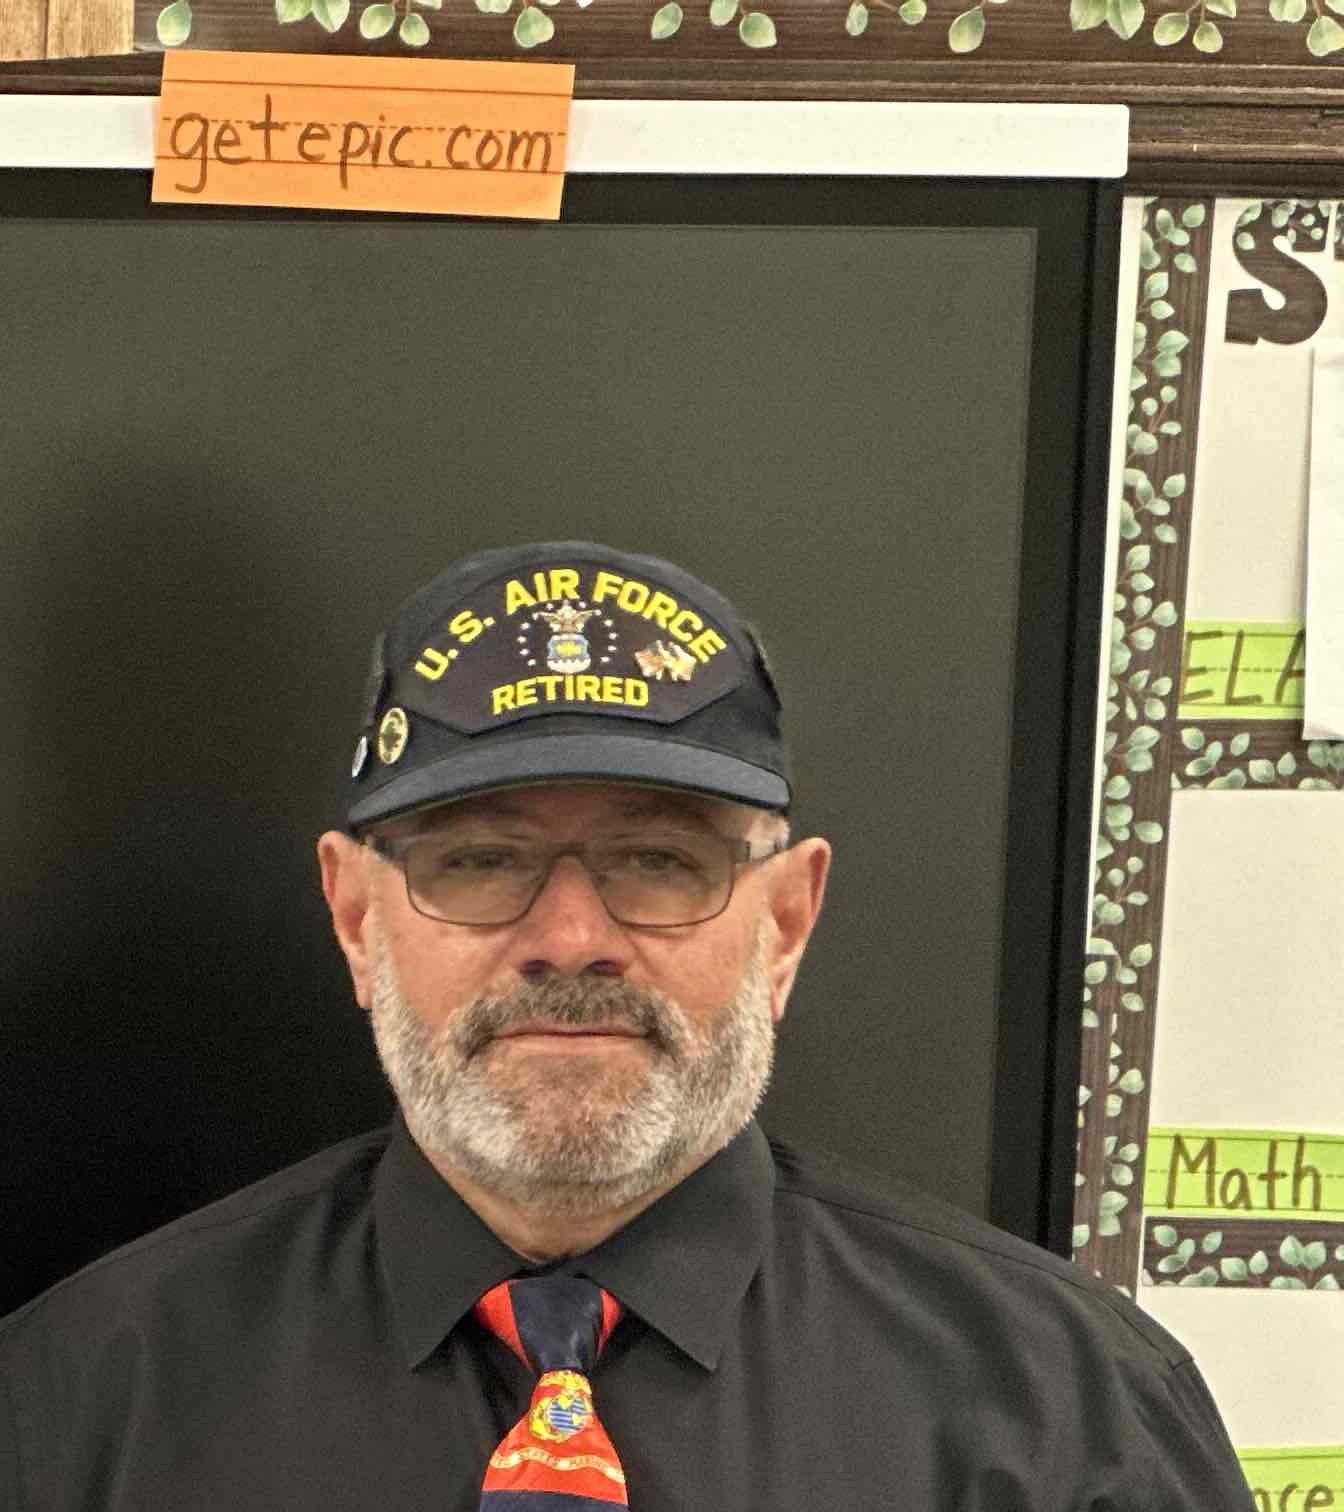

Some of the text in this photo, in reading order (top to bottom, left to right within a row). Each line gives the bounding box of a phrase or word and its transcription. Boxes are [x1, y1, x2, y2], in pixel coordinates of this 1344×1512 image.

[171, 94, 552, 194] getepic.com
[415, 568, 726, 681] U.S. AIR FORCE
[491, 675, 649, 715] RETIRED
[1165, 1134, 1322, 1210] Math
